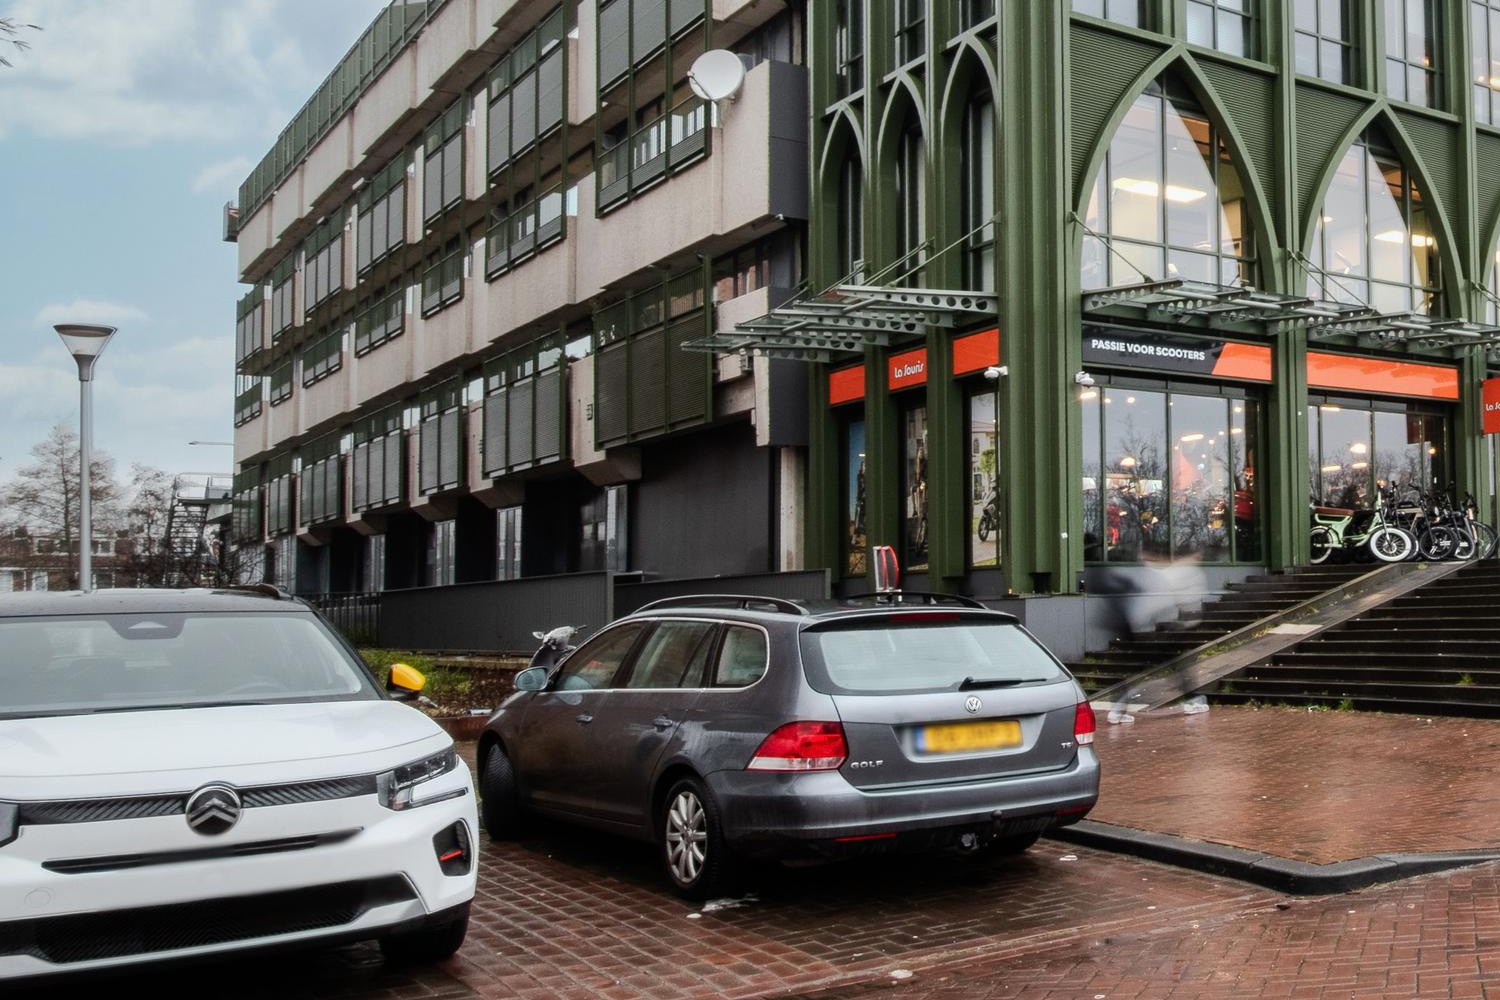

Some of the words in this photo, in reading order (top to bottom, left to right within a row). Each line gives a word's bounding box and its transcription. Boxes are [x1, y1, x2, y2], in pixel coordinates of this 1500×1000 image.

[1092, 339, 1125, 352] PASSIE
[1126, 343, 1155, 355] VOOR
[1155, 347, 1206, 361] SCOOTERS
[1485, 403, 1494, 411] La
[850, 760, 884, 769] GOLF
